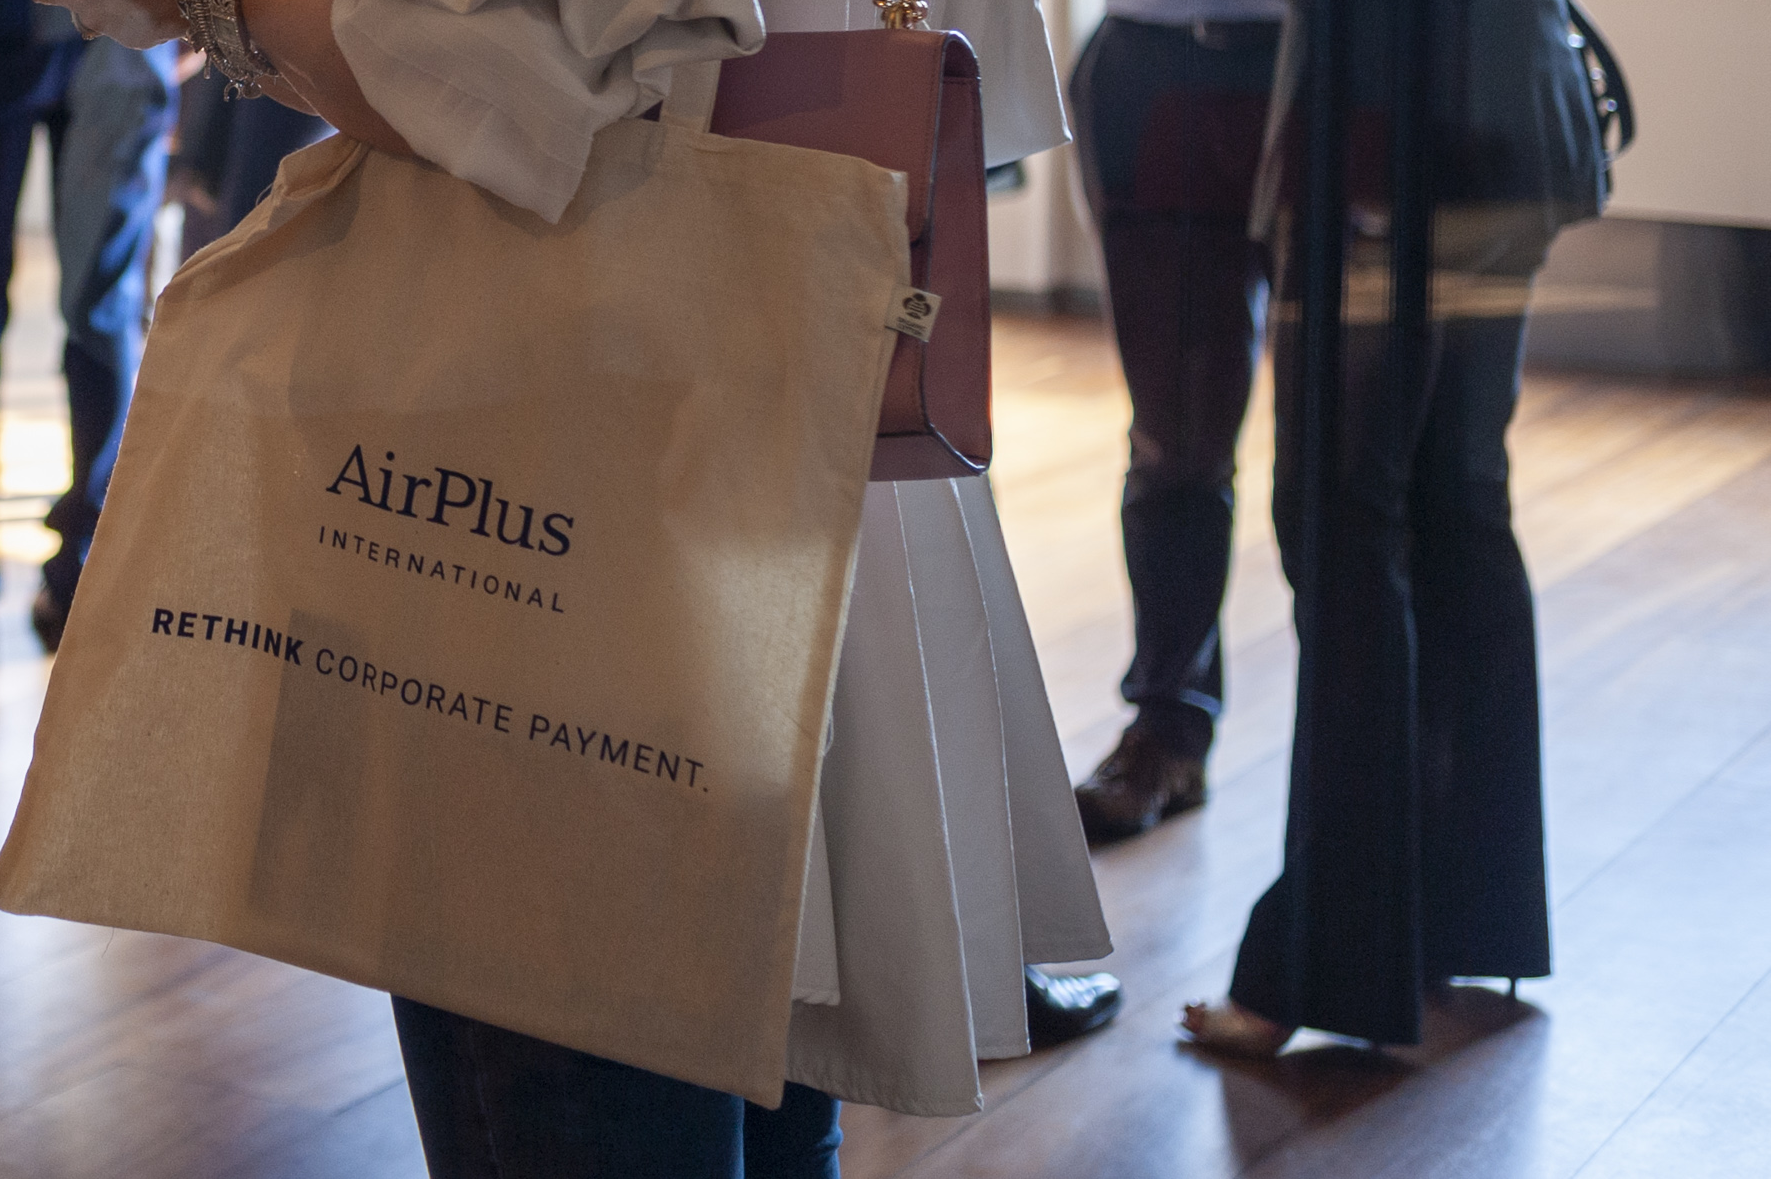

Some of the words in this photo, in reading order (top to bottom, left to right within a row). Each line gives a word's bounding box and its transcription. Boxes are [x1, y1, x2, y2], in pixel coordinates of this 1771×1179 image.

[326, 444, 574, 556] AirPlus
[319, 526, 564, 613] INTERNATIONAL
[151, 608, 304, 666] RETHINK
[315, 648, 513, 733] CORPORATE
[529, 714, 709, 793] PAYMENT.
